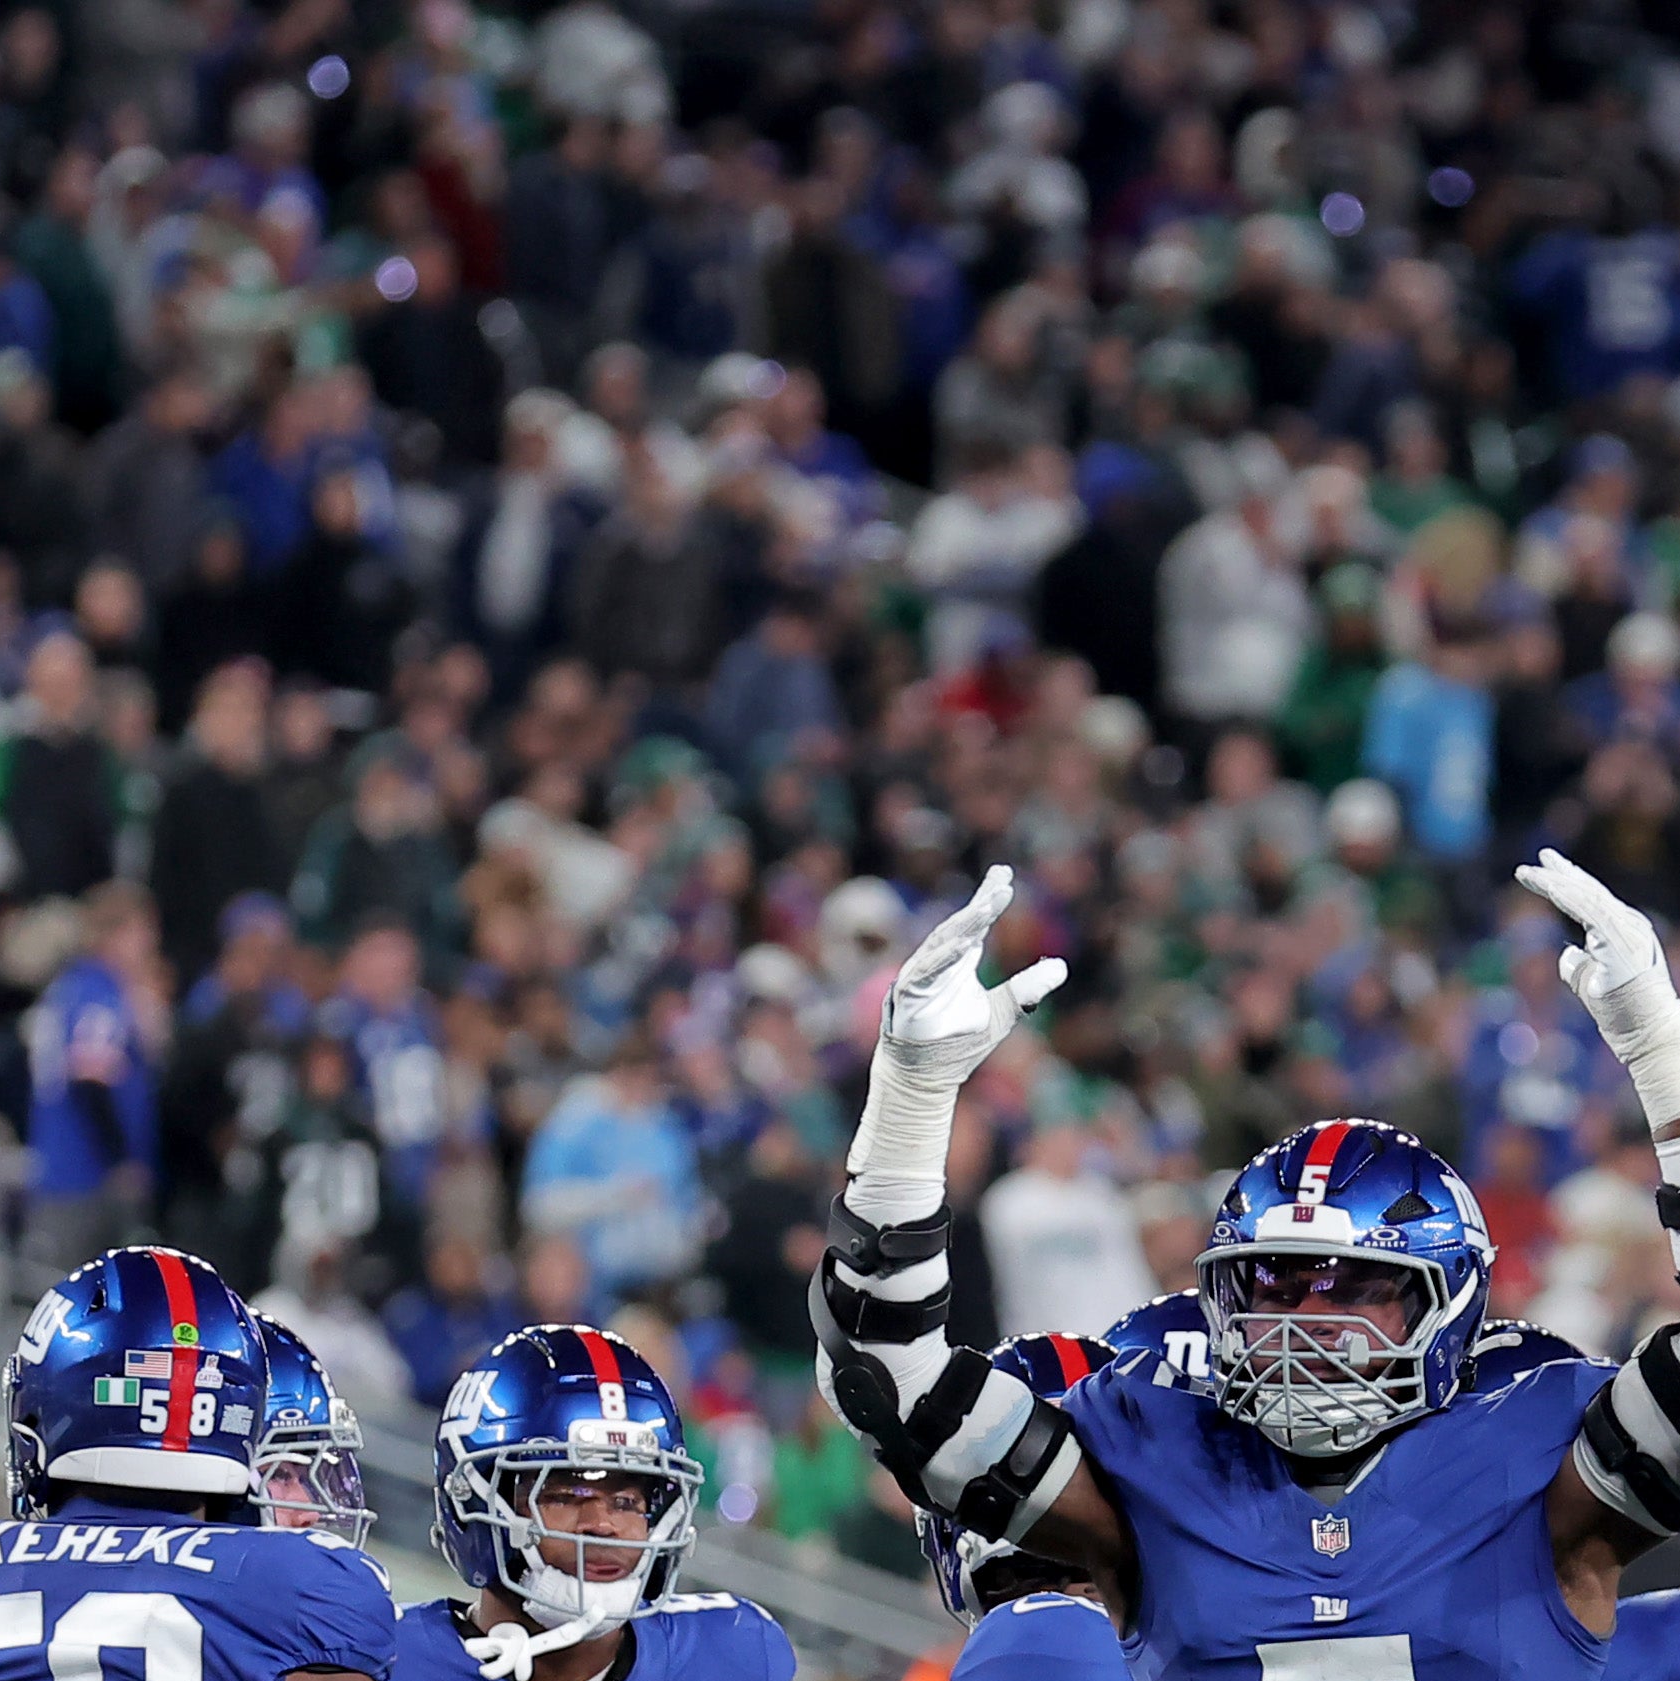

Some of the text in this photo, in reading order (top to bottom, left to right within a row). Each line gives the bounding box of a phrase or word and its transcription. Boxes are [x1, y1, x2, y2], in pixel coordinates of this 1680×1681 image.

[1297, 1164, 1332, 1205] 5
[1363, 1240, 1408, 1248] OAKLEY
[139, 1388, 217, 1436] 58
[598, 1382, 627, 1420] 8
